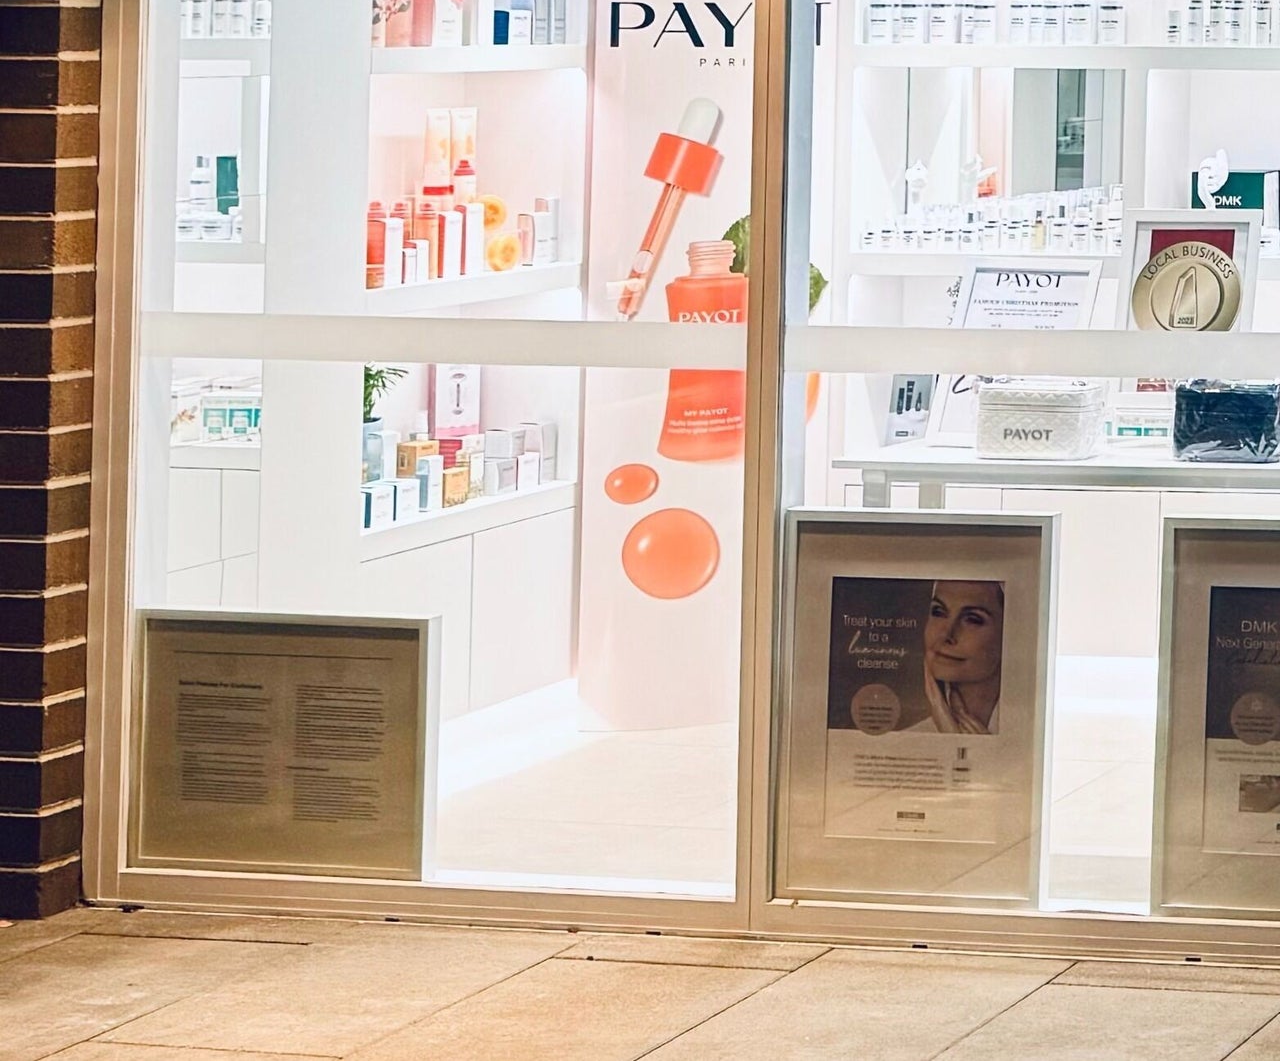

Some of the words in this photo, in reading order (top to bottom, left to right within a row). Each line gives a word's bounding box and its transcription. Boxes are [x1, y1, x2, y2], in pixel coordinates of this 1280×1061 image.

[1143, 249, 1179, 281] LOCAL
[1182, 245, 1234, 280] BUSINESS
[996, 272, 1061, 288] PAYOT
[1003, 428, 1053, 442] PAYOT
[843, 614, 867, 628] Treat
[870, 618, 893, 629] your
[896, 618, 918, 629] skin
[1241, 620, 1278, 633] DMK
[869, 631, 879, 642] to
[881, 633, 889, 642] a
[1216, 636, 1241, 649] Next
[857, 658, 899, 669] cleanse
